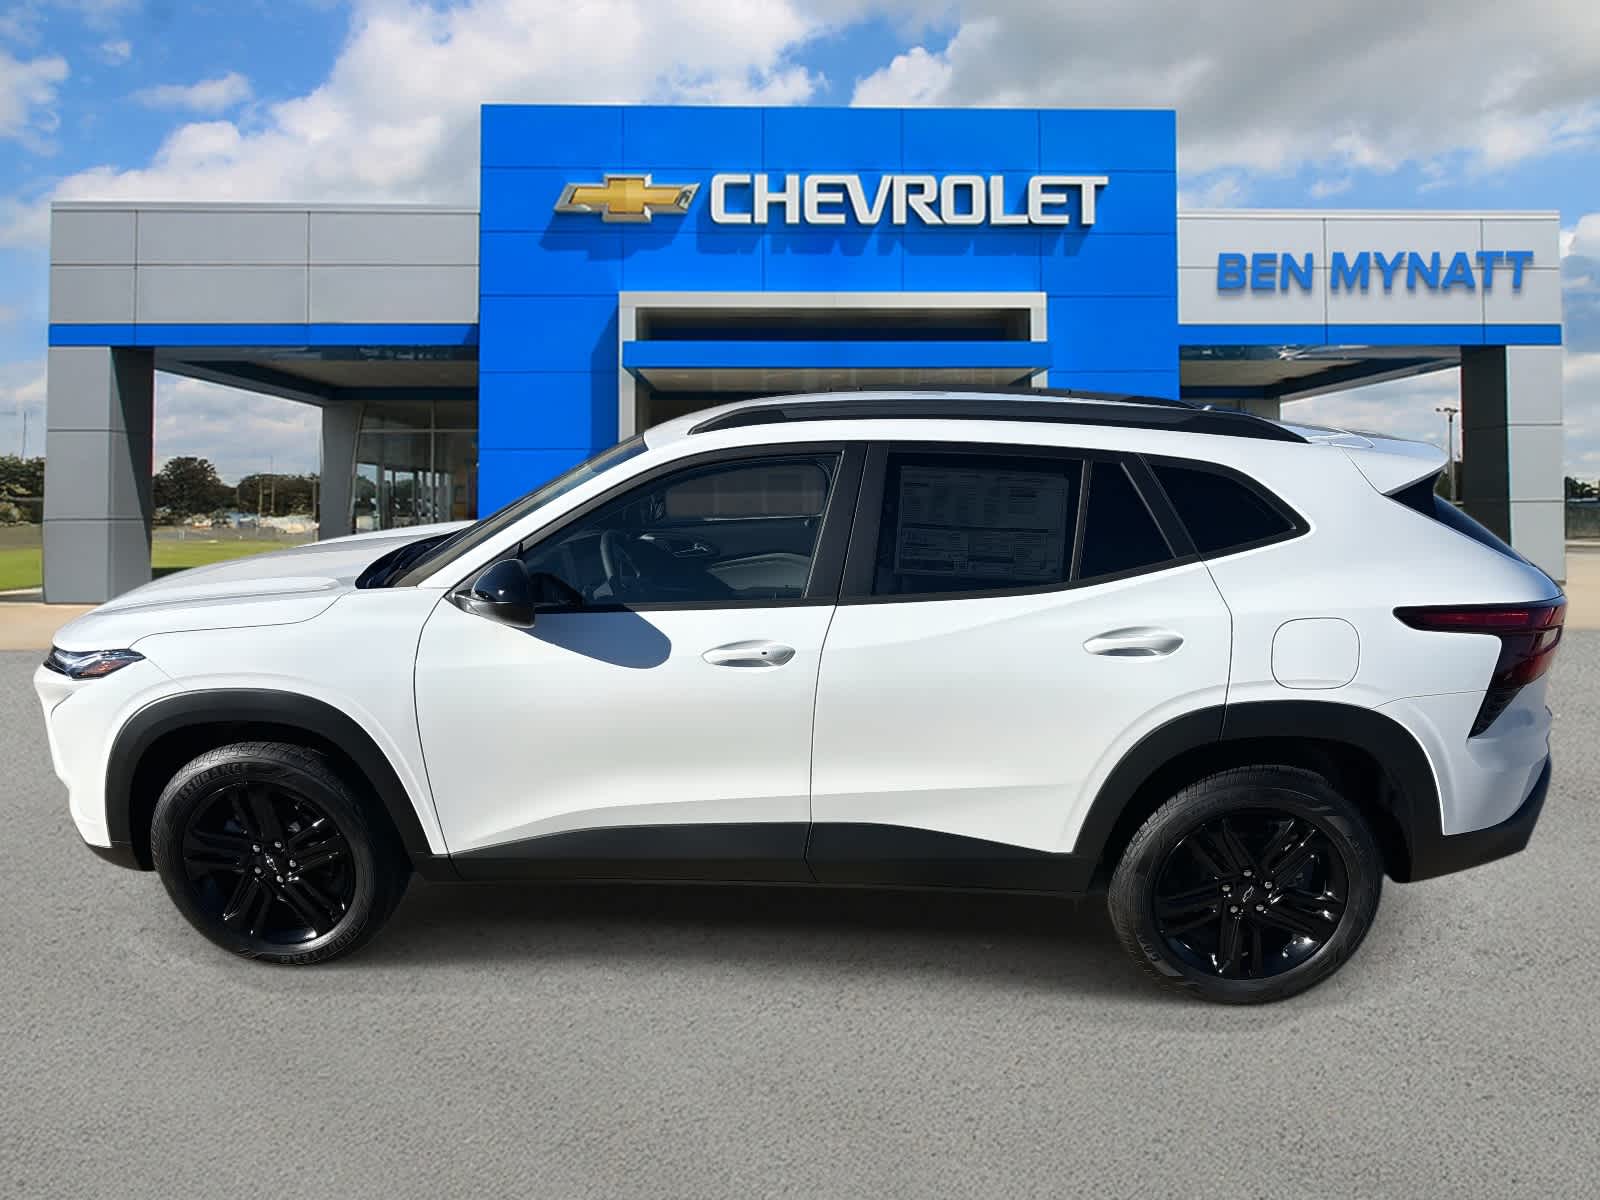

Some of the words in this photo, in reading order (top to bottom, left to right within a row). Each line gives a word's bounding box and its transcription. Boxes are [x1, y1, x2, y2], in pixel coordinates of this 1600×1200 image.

[709, 173, 1109, 225] CHEVROLET
[1217, 252, 1313, 291] BEN
[1330, 251, 1534, 290] MYNATT
[174, 763, 248, 802] SSURANC
